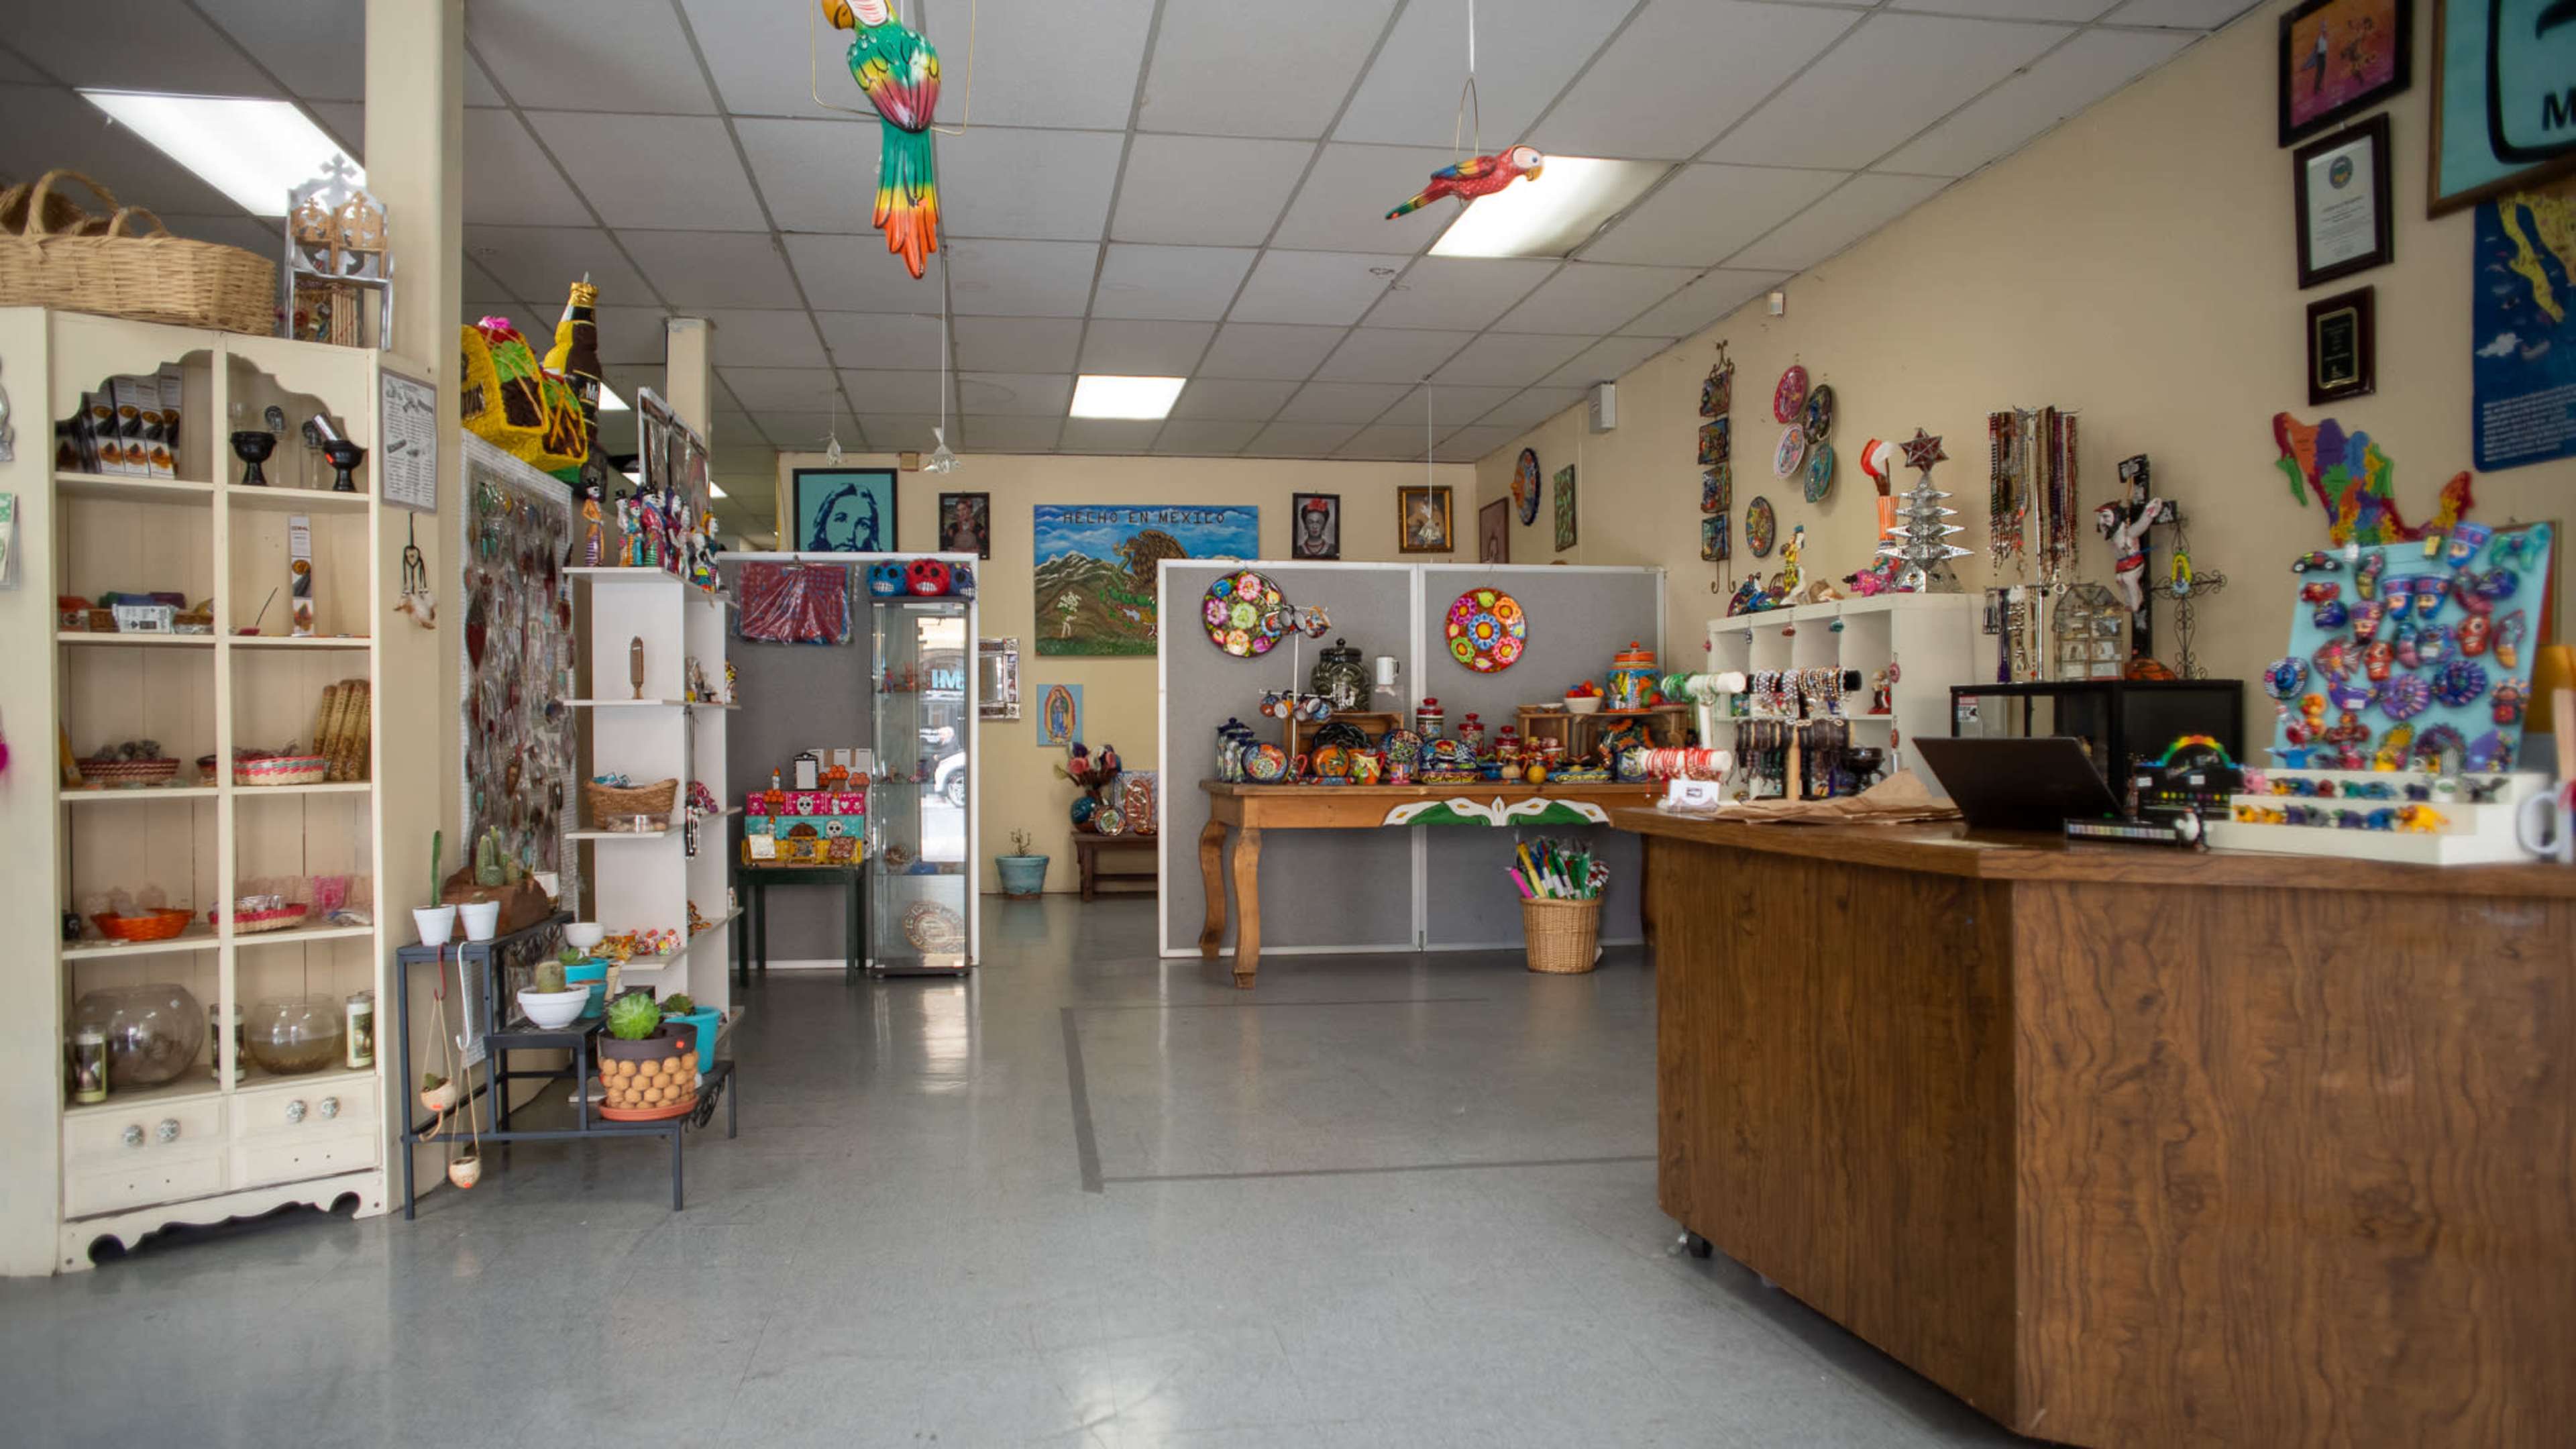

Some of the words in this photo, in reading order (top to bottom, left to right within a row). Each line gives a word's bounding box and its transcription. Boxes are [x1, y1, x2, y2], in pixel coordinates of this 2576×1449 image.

[1063, 511, 1118, 524] HECHO
[1128, 511, 1149, 523] EN
[1159, 511, 1225, 525] MEXICO
